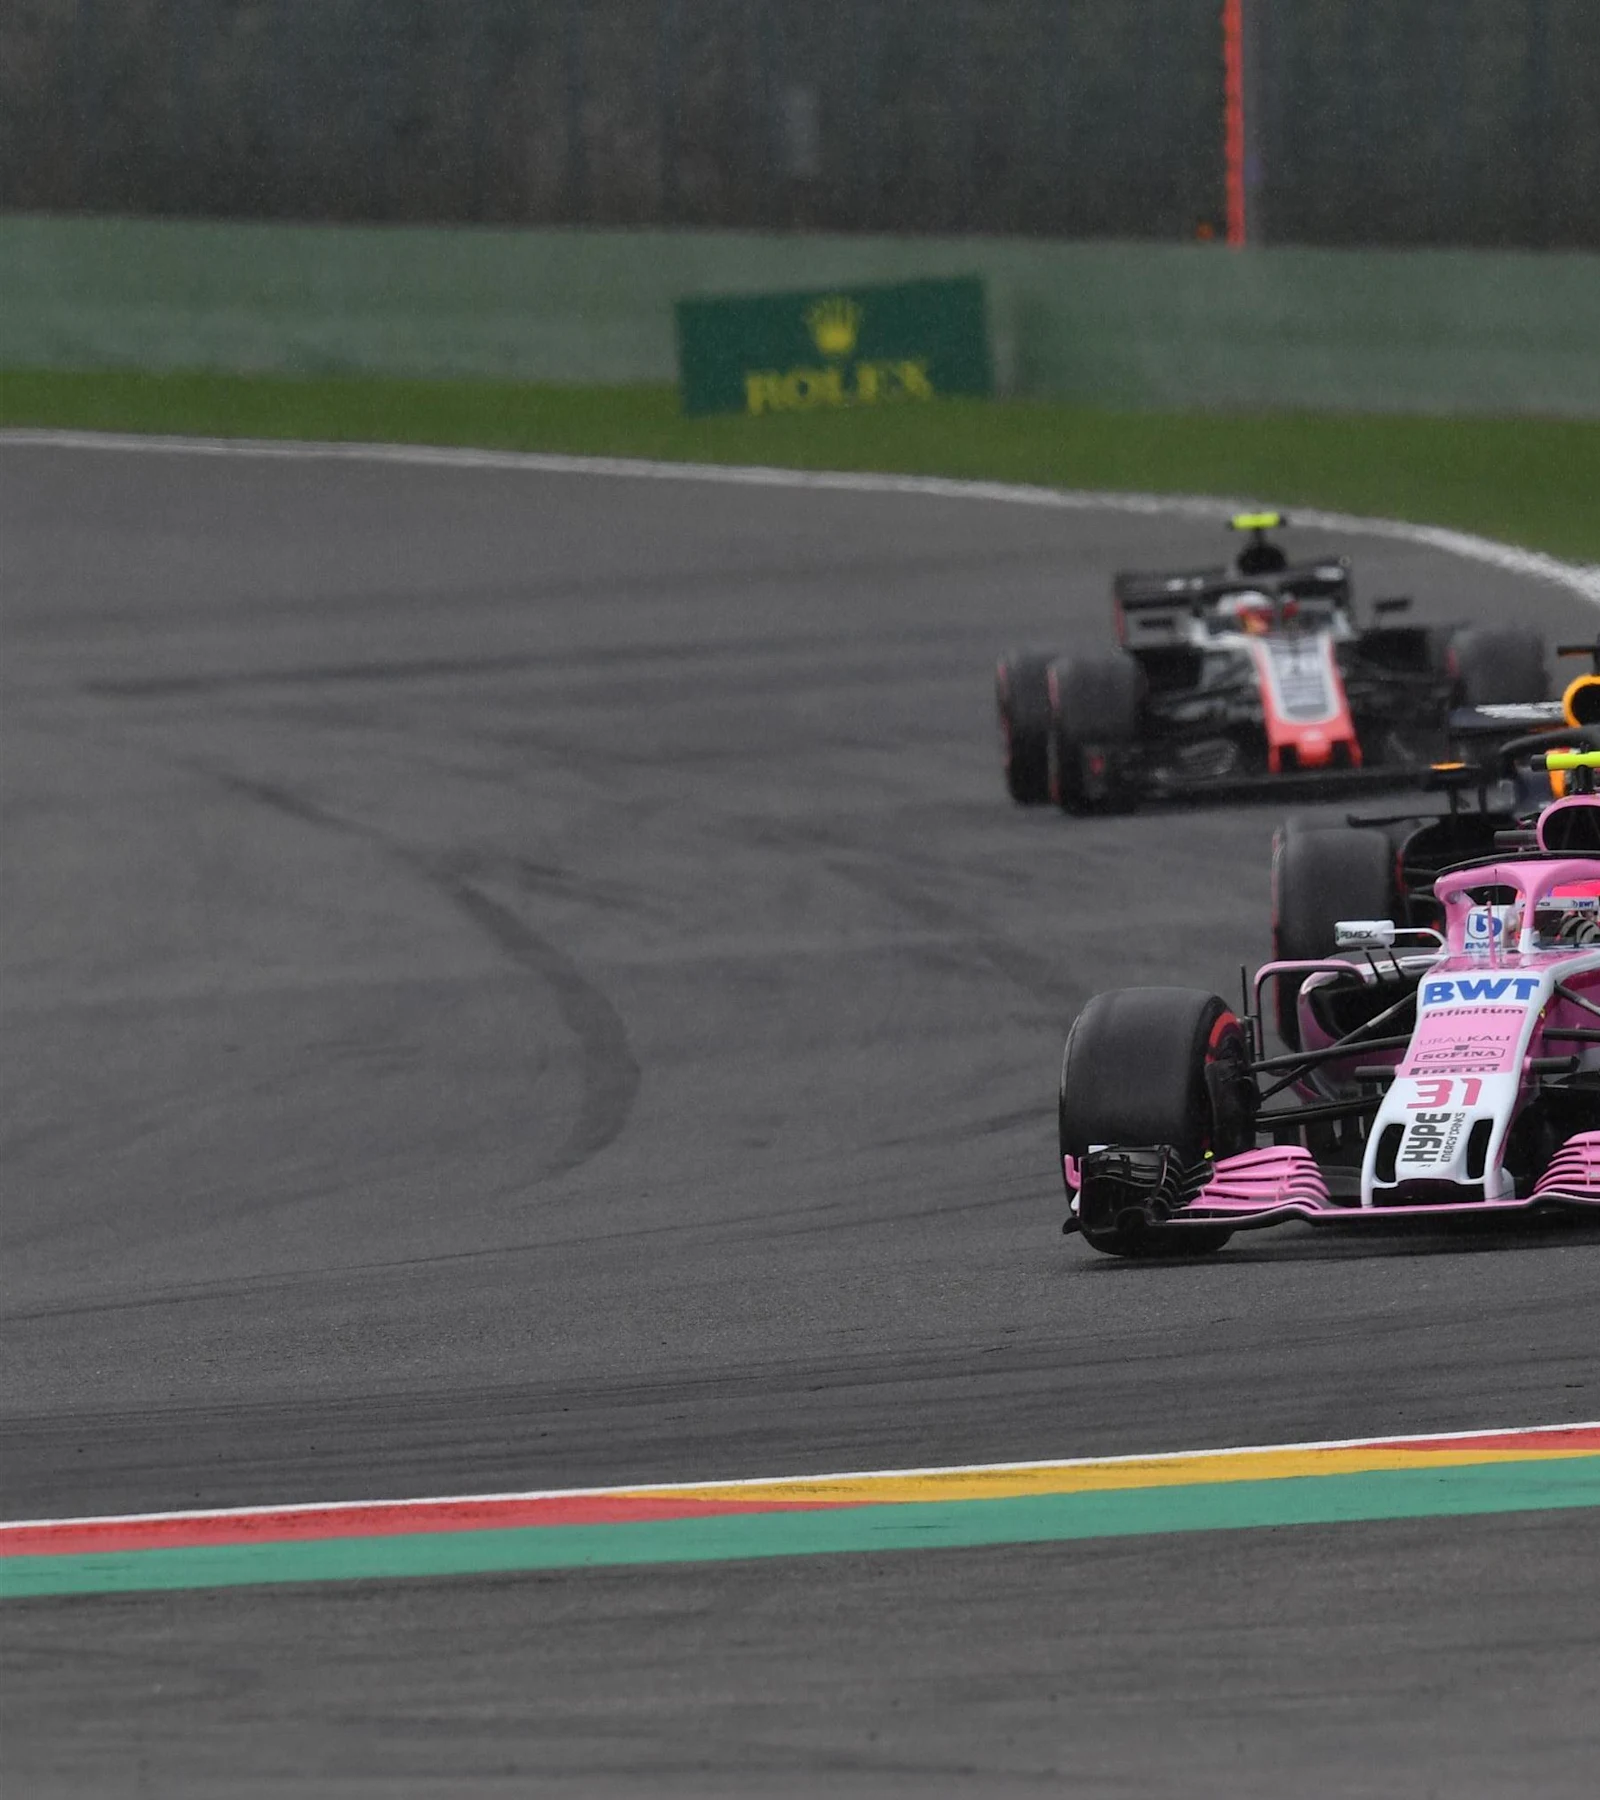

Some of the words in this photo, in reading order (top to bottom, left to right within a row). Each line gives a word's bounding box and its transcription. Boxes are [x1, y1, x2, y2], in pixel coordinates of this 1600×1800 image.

[744, 361, 934, 416] ROLEX
[1423, 978, 1540, 1006] BWT
[1424, 1007, 1523, 1019] infinitum
[1419, 1034, 1511, 1046] URALKALI
[1421, 1050, 1497, 1061] SOFINA
[1406, 1078, 1483, 1109] 31
[1401, 1112, 1452, 1163] HYPE
